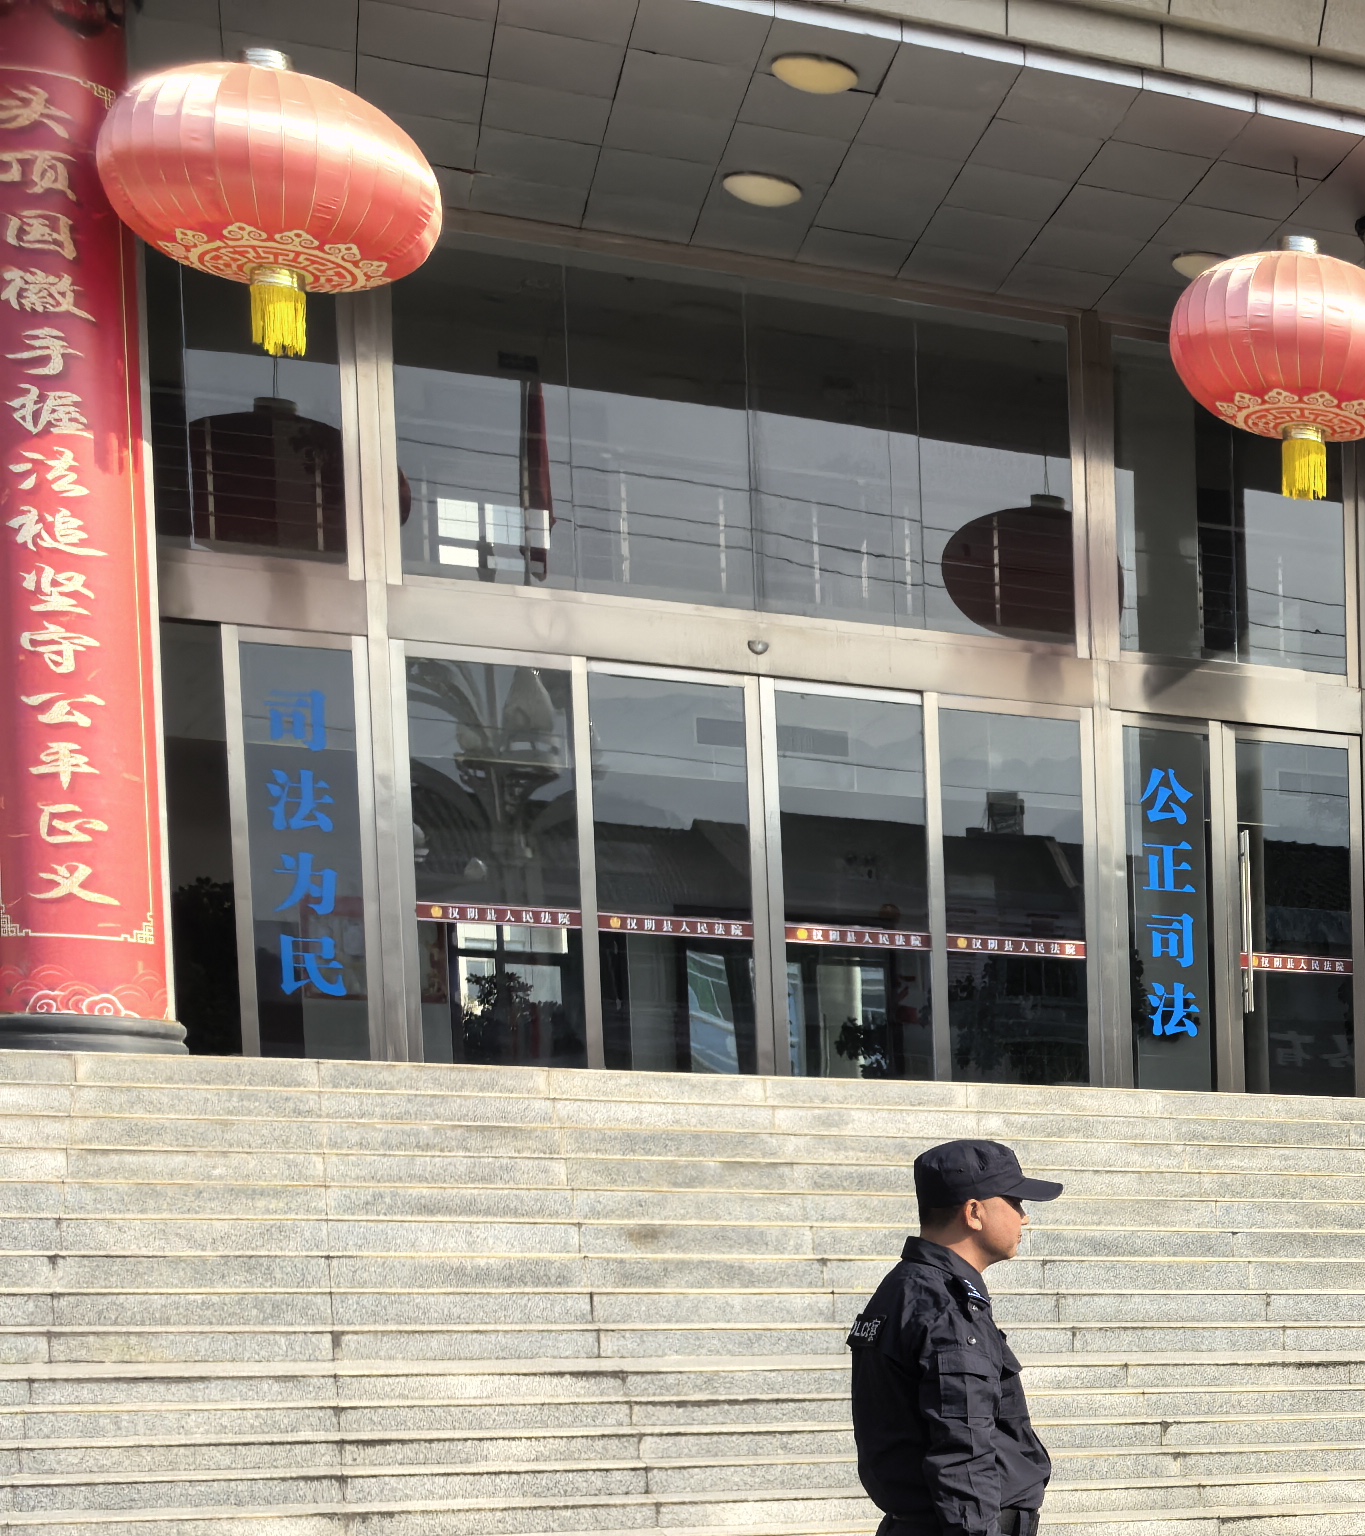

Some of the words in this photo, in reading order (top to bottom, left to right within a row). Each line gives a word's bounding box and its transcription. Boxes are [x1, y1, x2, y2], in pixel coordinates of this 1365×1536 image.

[264, 689, 347, 996] 司法为民
[1140, 768, 1200, 1037] 公正司法
[448, 906, 571, 925] 汉阴县人民法院
[626, 916, 743, 936] 汉阴县人民法院
[812, 929, 923, 948] 汉阴县人民法院
[972, 938, 1077, 956] 汉阴县人民法院
[1261, 956, 1345, 972] 汉阴县人民法院
